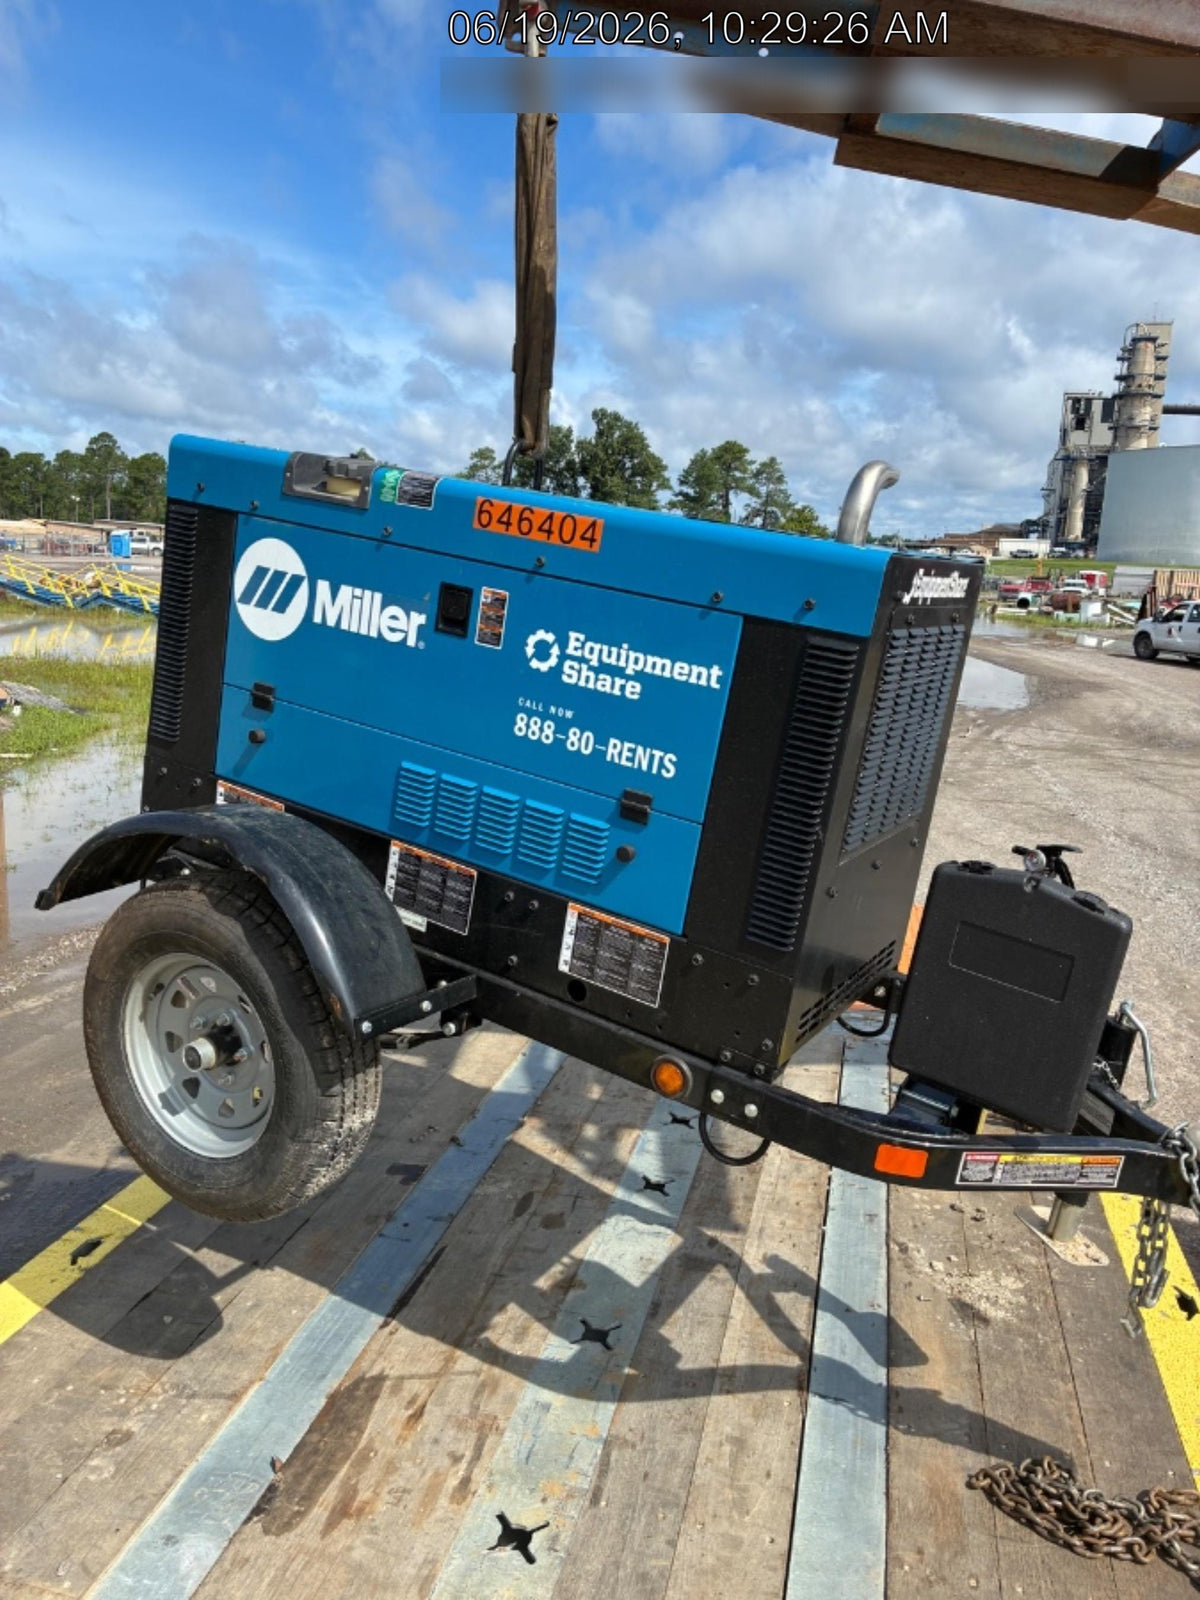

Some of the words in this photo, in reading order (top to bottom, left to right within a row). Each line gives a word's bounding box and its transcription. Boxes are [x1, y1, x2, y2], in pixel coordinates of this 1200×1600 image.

[476, 498, 598, 549] 646404
[312, 578, 427, 648] Miller
[561, 659, 642, 700] Share
[565, 630, 723, 690] Equipment
[518, 697, 544, 712] CALL
[548, 704, 575, 719] NOW
[513, 712, 678, 779] 888-80-RENTS
